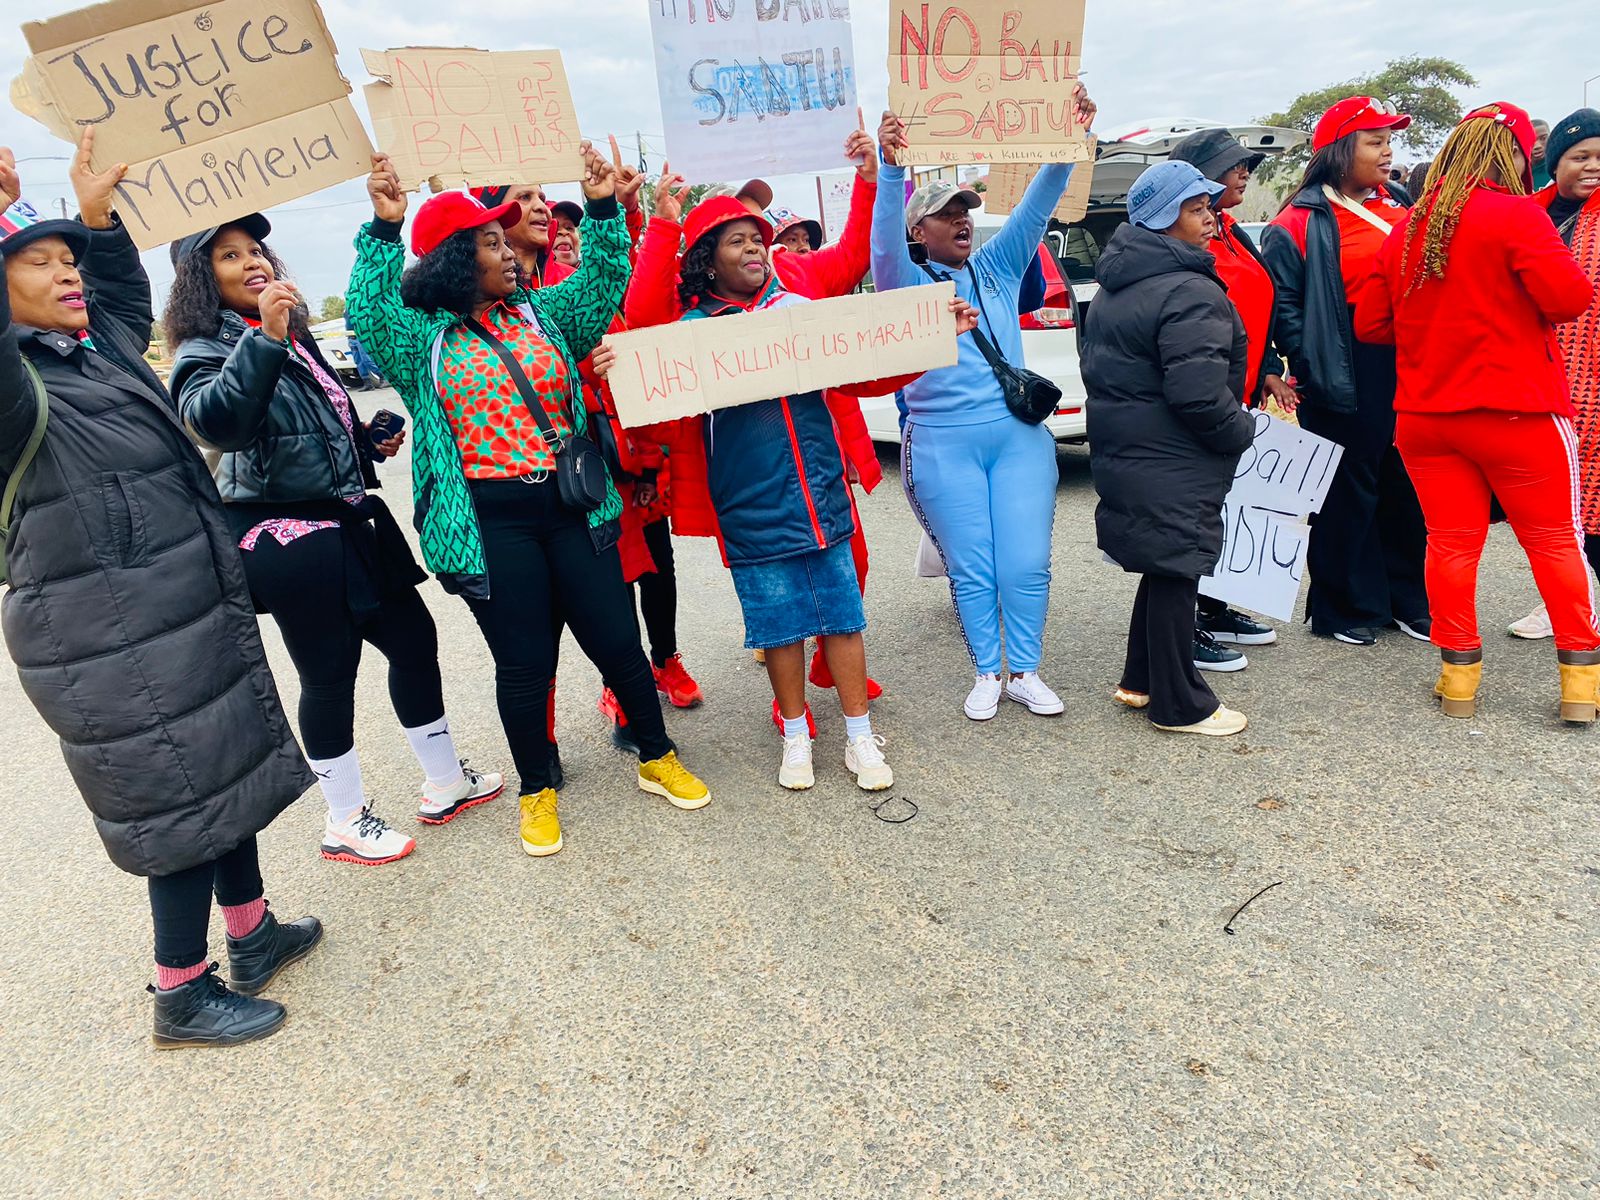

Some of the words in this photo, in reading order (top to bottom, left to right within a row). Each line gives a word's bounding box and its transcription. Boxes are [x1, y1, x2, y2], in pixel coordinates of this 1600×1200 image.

[48, 11, 313, 127] Justice
[900, 3, 981, 90] NO
[998, 10, 1079, 83] BAIL
[160, 83, 237, 145] for
[395, 57, 491, 117] NO
[412, 120, 548, 166] BAIL
[939, 150, 958, 162] ARE
[635, 347, 699, 402] WHY
[711, 333, 811, 381] KILLING
[822, 332, 849, 356] US
[856, 299, 942, 351] MARA!!!
